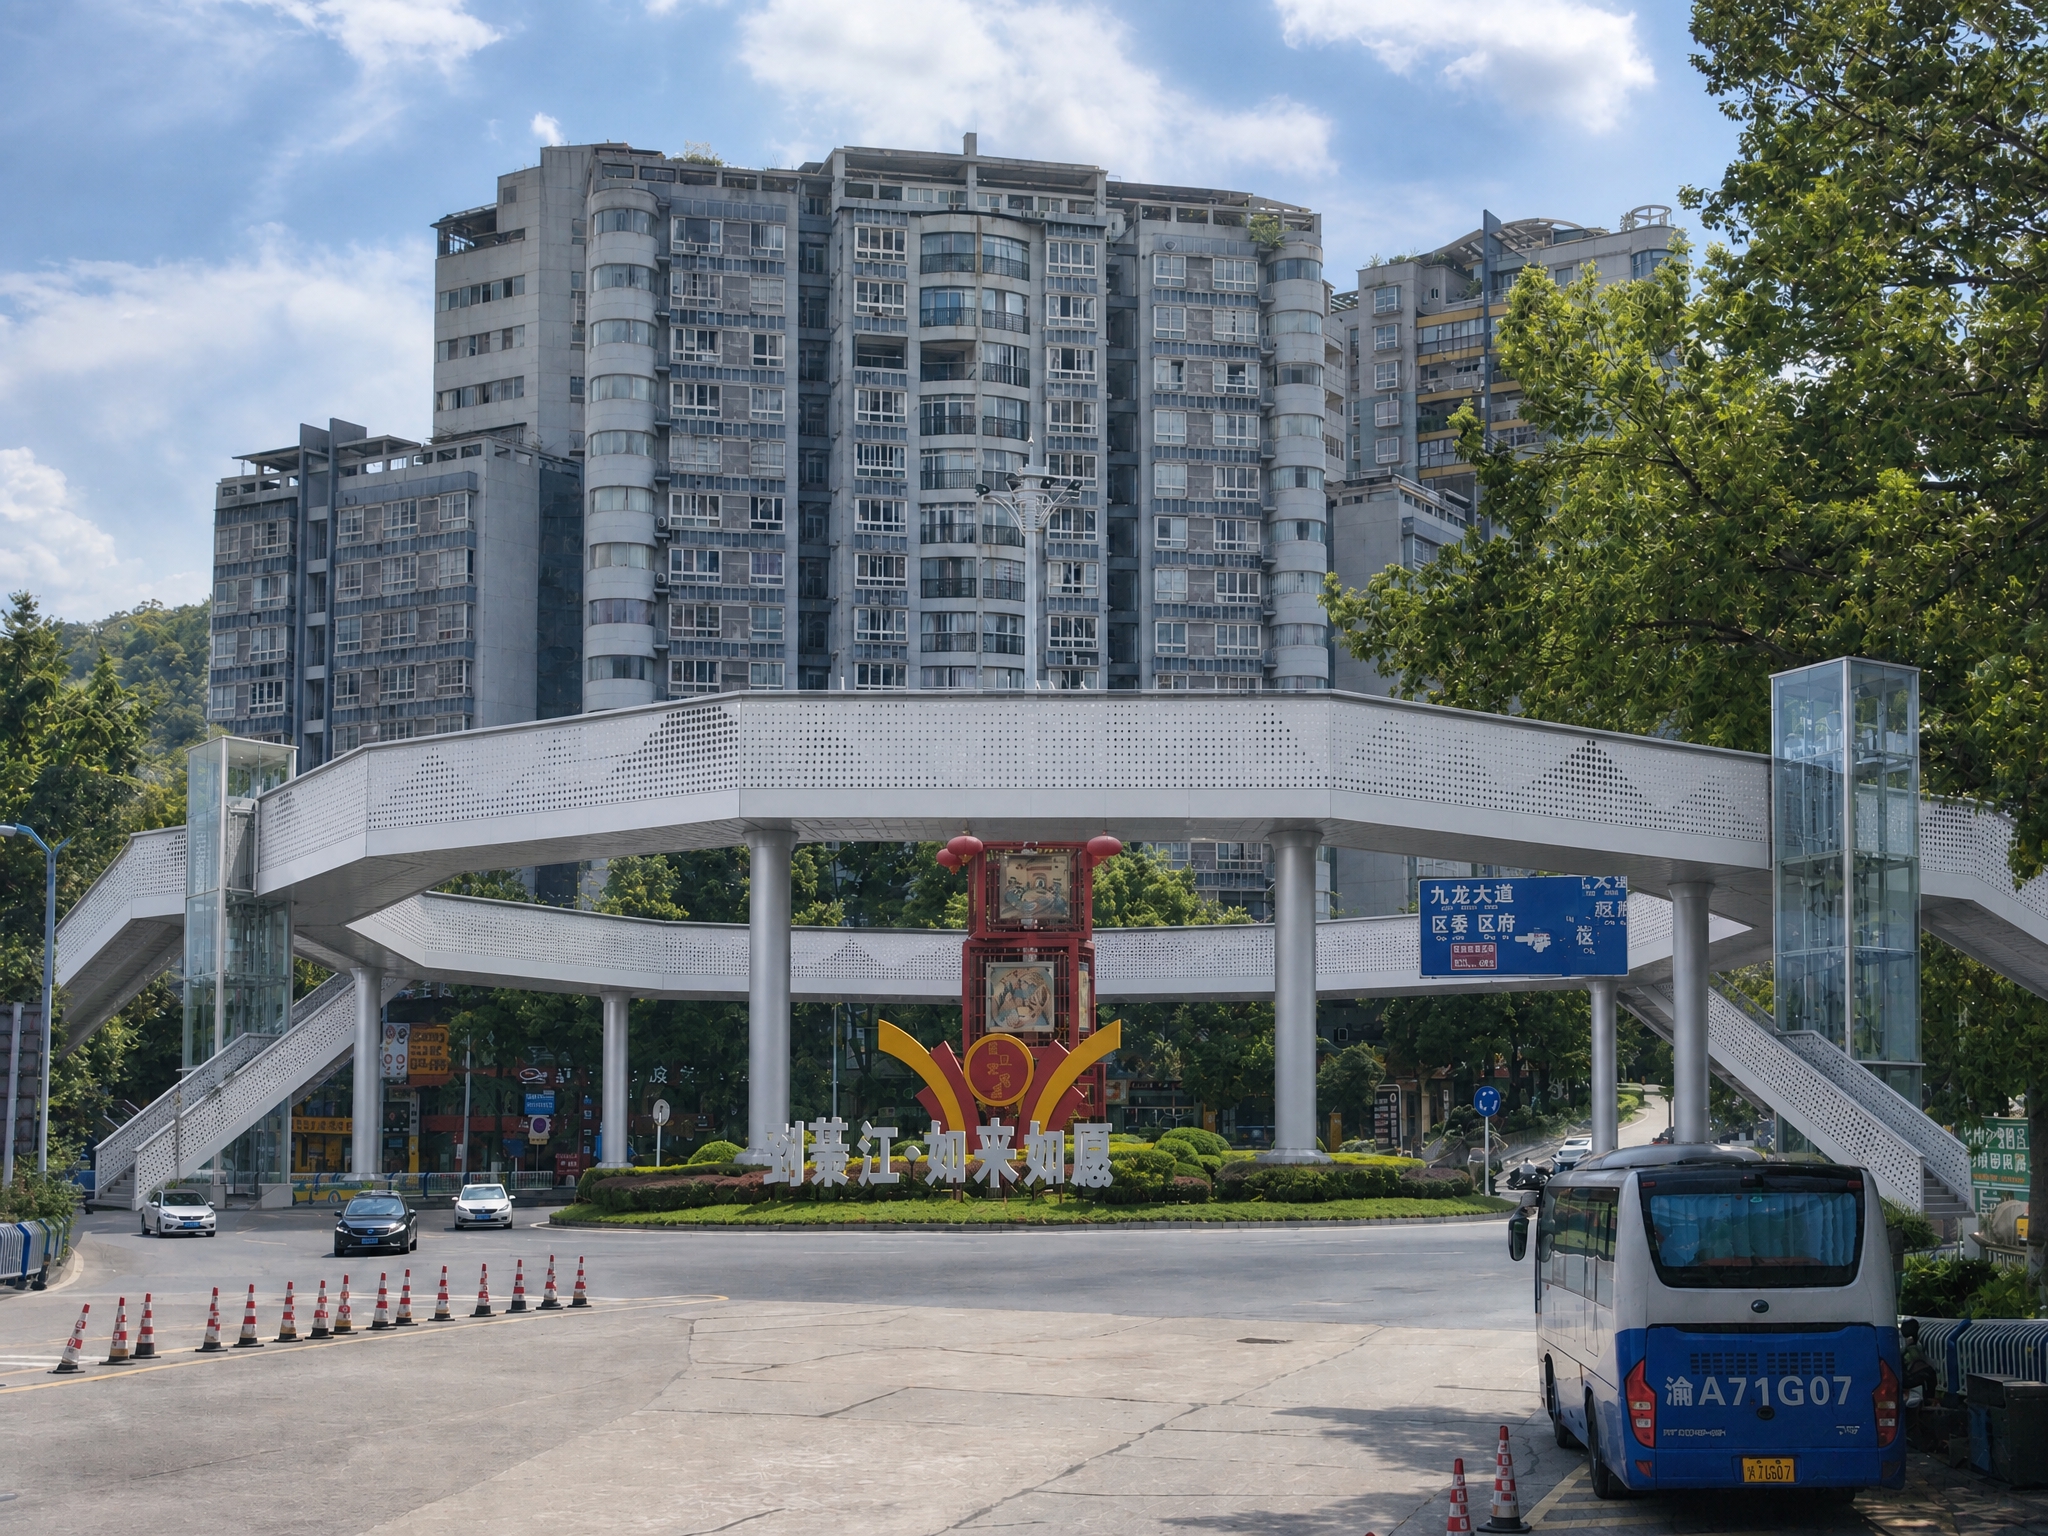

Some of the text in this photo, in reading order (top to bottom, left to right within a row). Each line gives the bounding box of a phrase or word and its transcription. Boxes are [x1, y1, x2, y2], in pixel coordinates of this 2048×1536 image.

[1430, 884, 1514, 905] 九龙大道
[1432, 912, 1515, 934] 区委 区府
[1665, 1376, 1852, 1407] 渝A71G07
